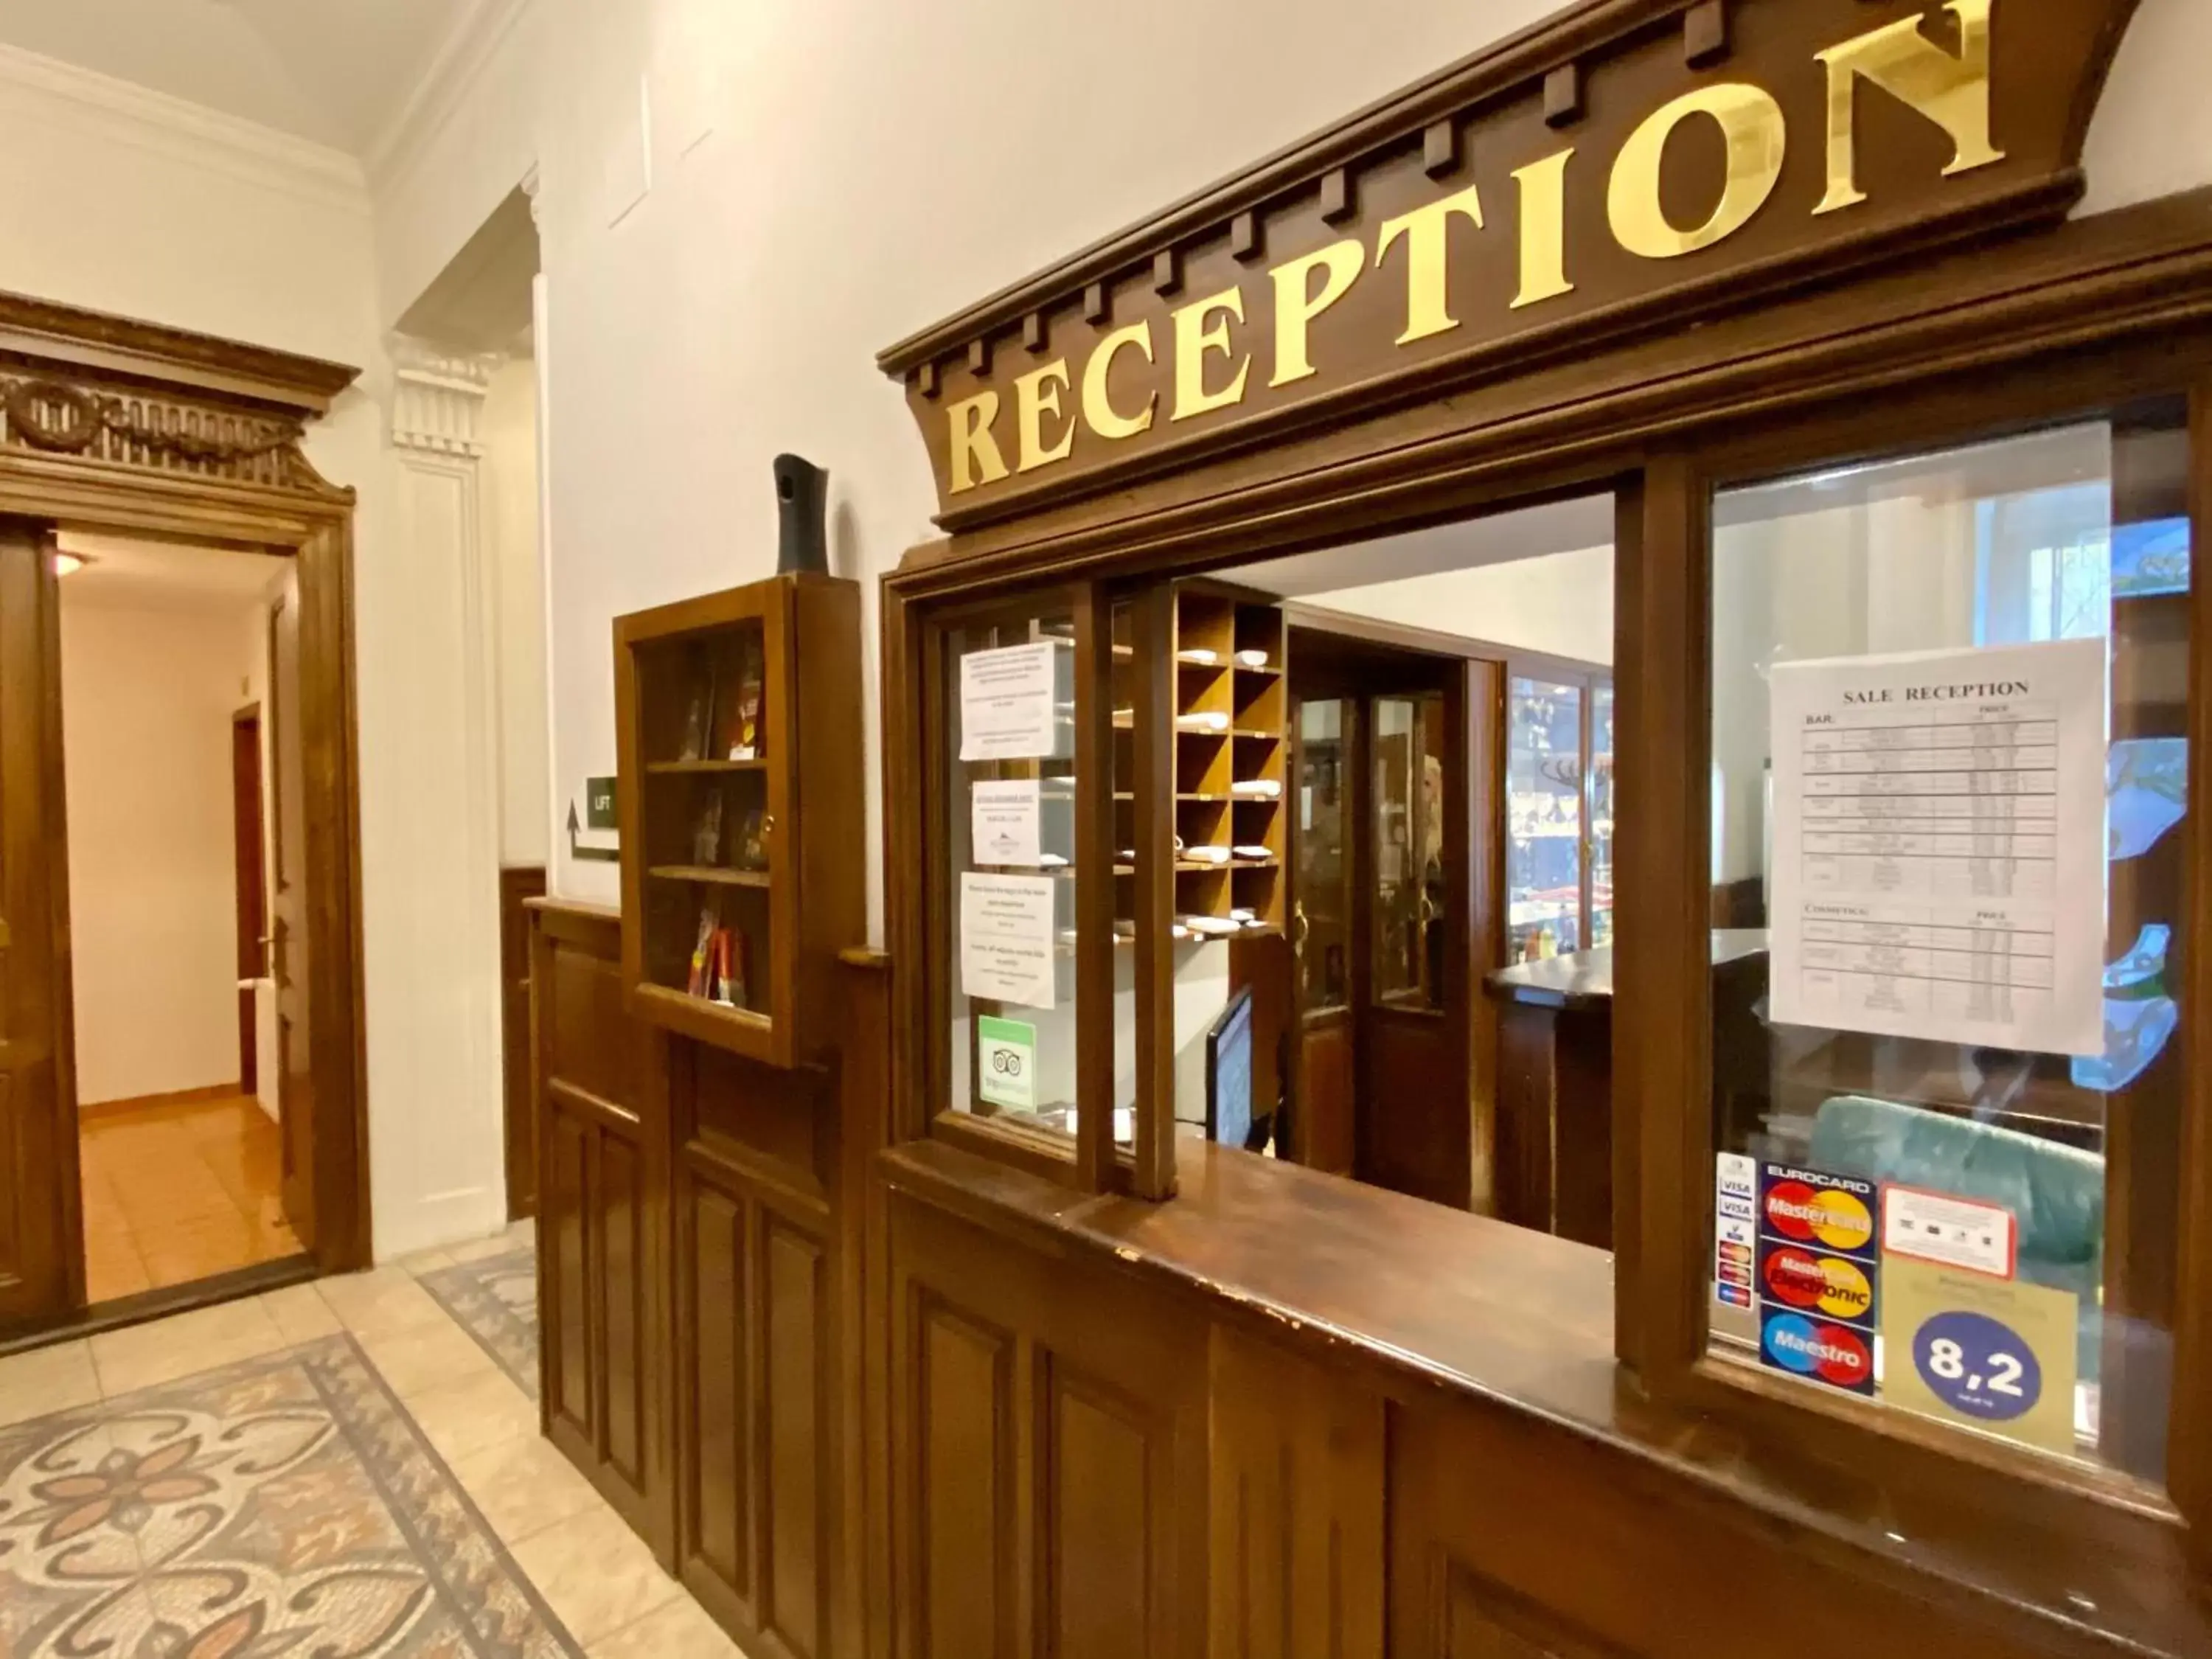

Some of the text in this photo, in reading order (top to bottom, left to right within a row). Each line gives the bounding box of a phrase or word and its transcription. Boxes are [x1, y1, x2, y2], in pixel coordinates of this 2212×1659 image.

[948, 0, 2006, 495] RECEPTION
[1843, 679, 2030, 705] SALE RECEPTION
[594, 794, 611, 811] LIFT
[1724, 1180, 1751, 1194] VISA
[1767, 1164, 1871, 1194] EUROCARD
[1724, 1202, 1751, 1216] VISA
[1774, 1329, 1861, 1368] Maestro
[1928, 1338, 2024, 1398] 8,2
